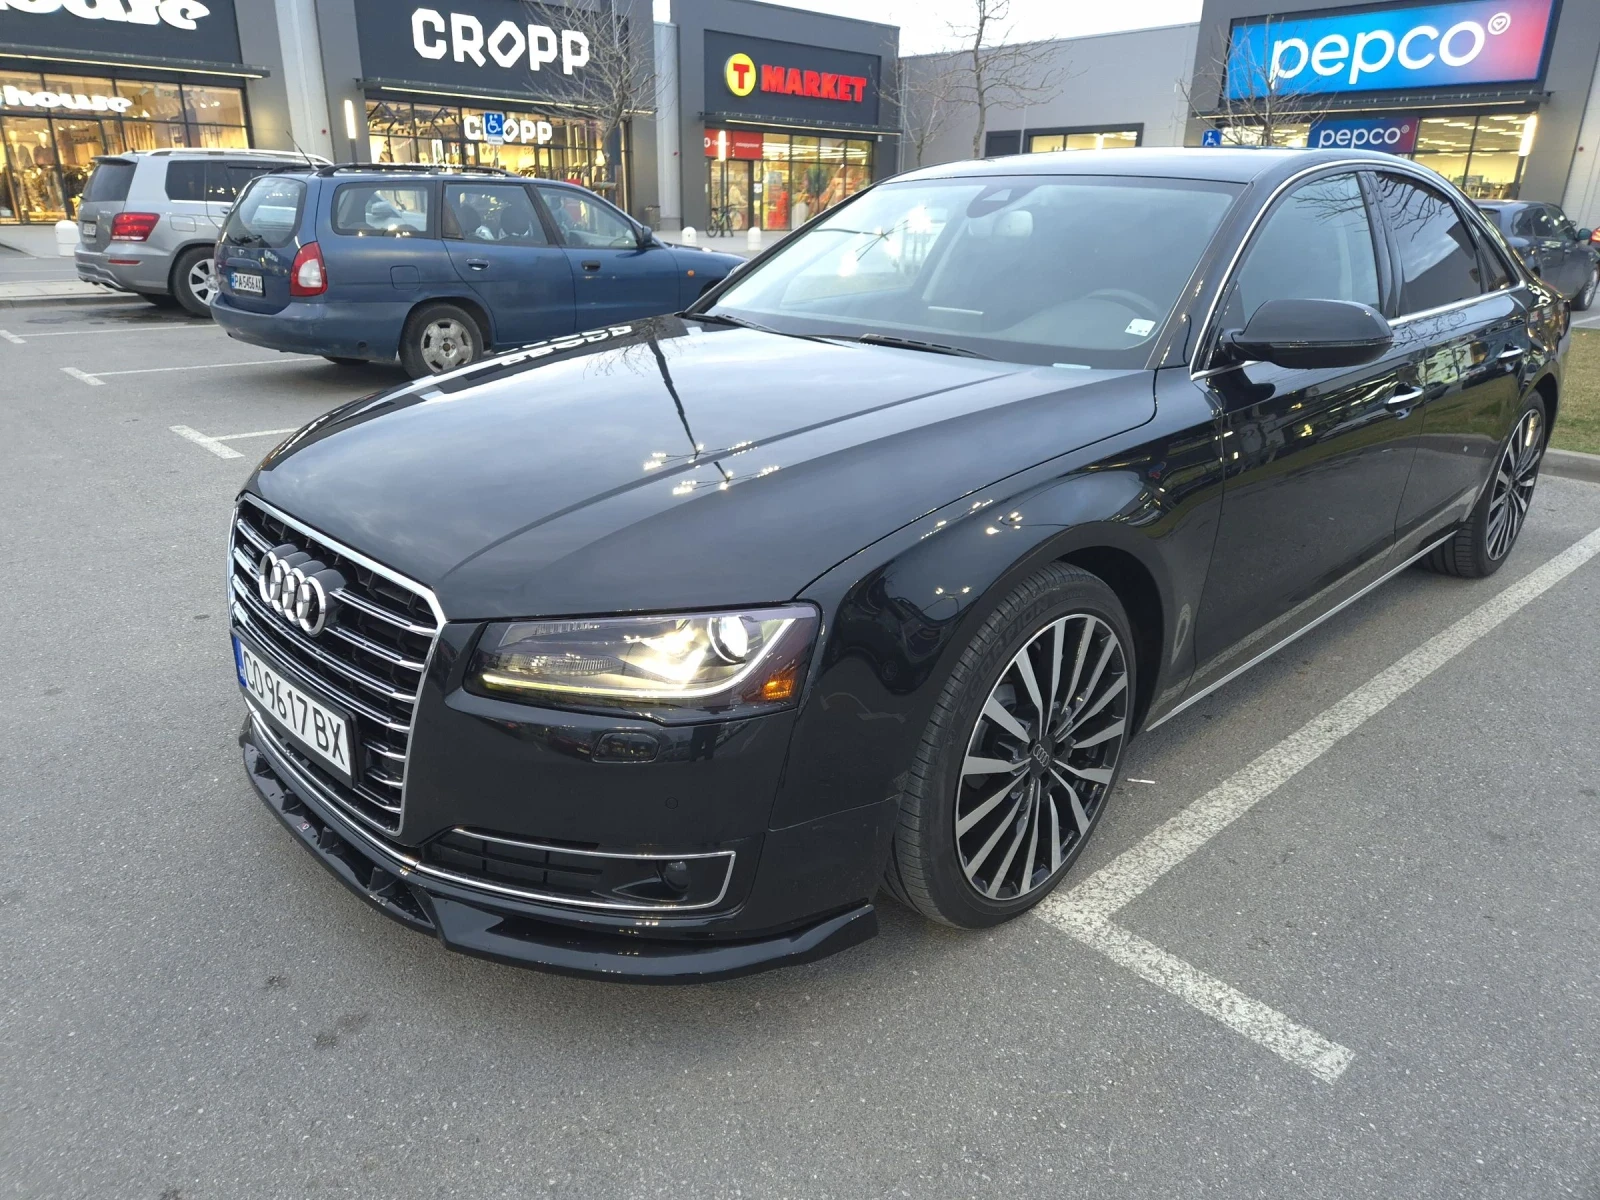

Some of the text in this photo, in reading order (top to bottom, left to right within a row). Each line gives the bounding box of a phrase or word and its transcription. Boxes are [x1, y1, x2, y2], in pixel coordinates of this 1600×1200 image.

[411, 7, 591, 75] CROPP
[1270, 21, 1485, 89] pepco
[760, 64, 867, 103] MARKET
[464, 115, 553, 144] COPP
[1318, 124, 1401, 149] pepco
